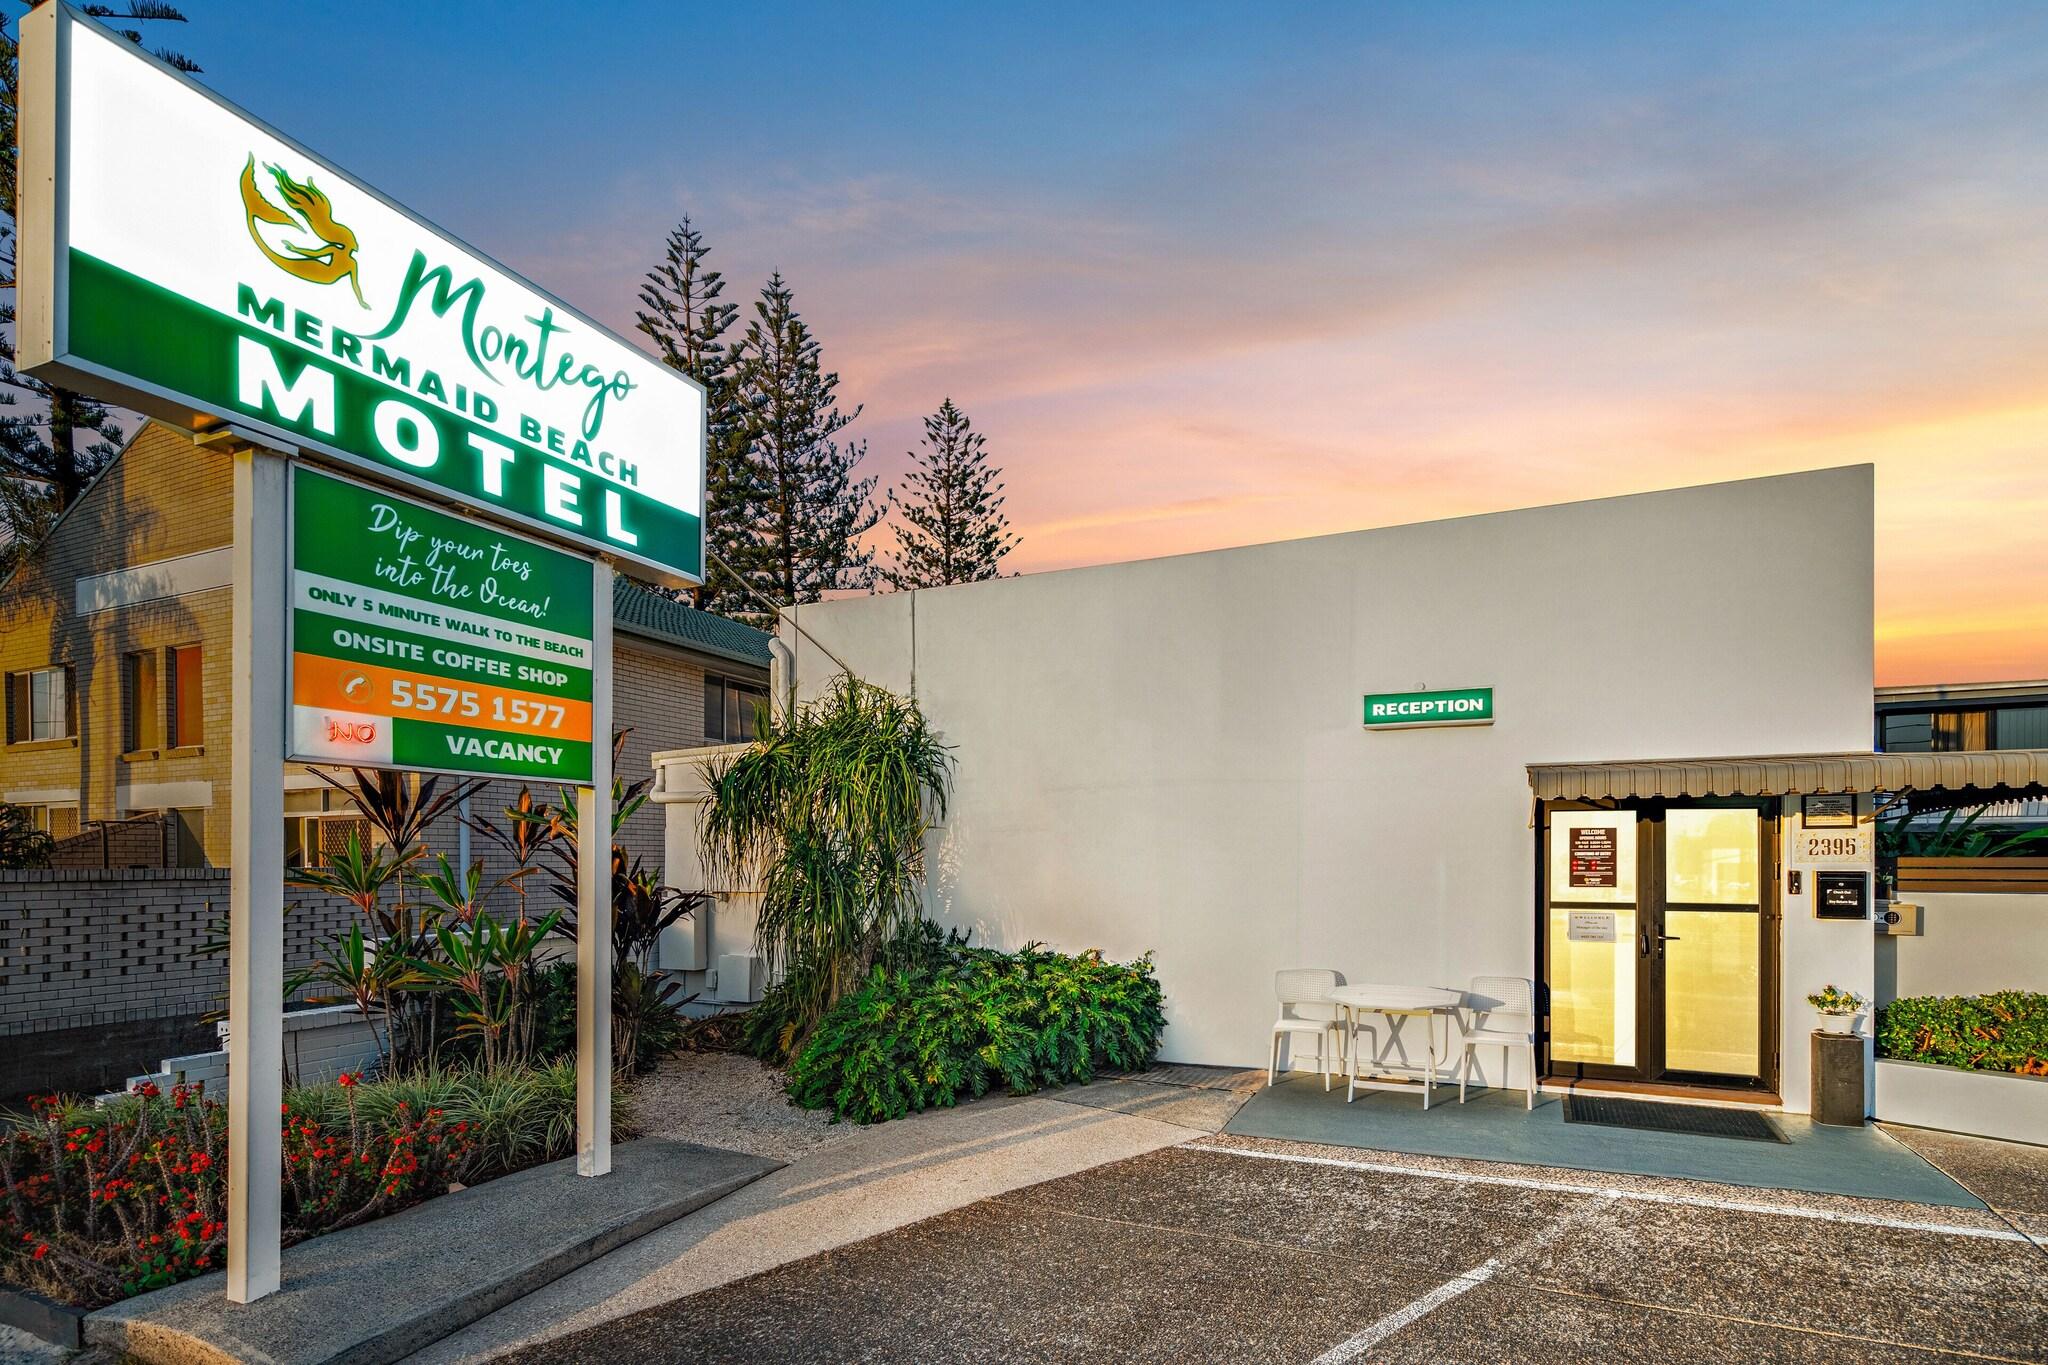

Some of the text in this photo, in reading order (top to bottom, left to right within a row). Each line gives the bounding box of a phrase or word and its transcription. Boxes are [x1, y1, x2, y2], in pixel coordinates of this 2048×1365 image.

[350, 248, 638, 441] Montego
[237, 282, 638, 487] MERMAID BEACH
[238, 335, 638, 548] MOTEL
[368, 503, 533, 581] Dip your toes
[375, 555, 551, 619] into the Ocean!
[308, 586, 584, 659] ONLY 5 MINUTE WALK TO THE BEACH
[332, 629, 568, 688] ONSITE COFFEE SHOP
[328, 720, 377, 744] NO
[391, 679, 565, 729] 5575 1577
[1372, 698, 1484, 717] RECEPTION
[446, 734, 563, 765] VACANCY
[1808, 838, 1856, 856] 2395
